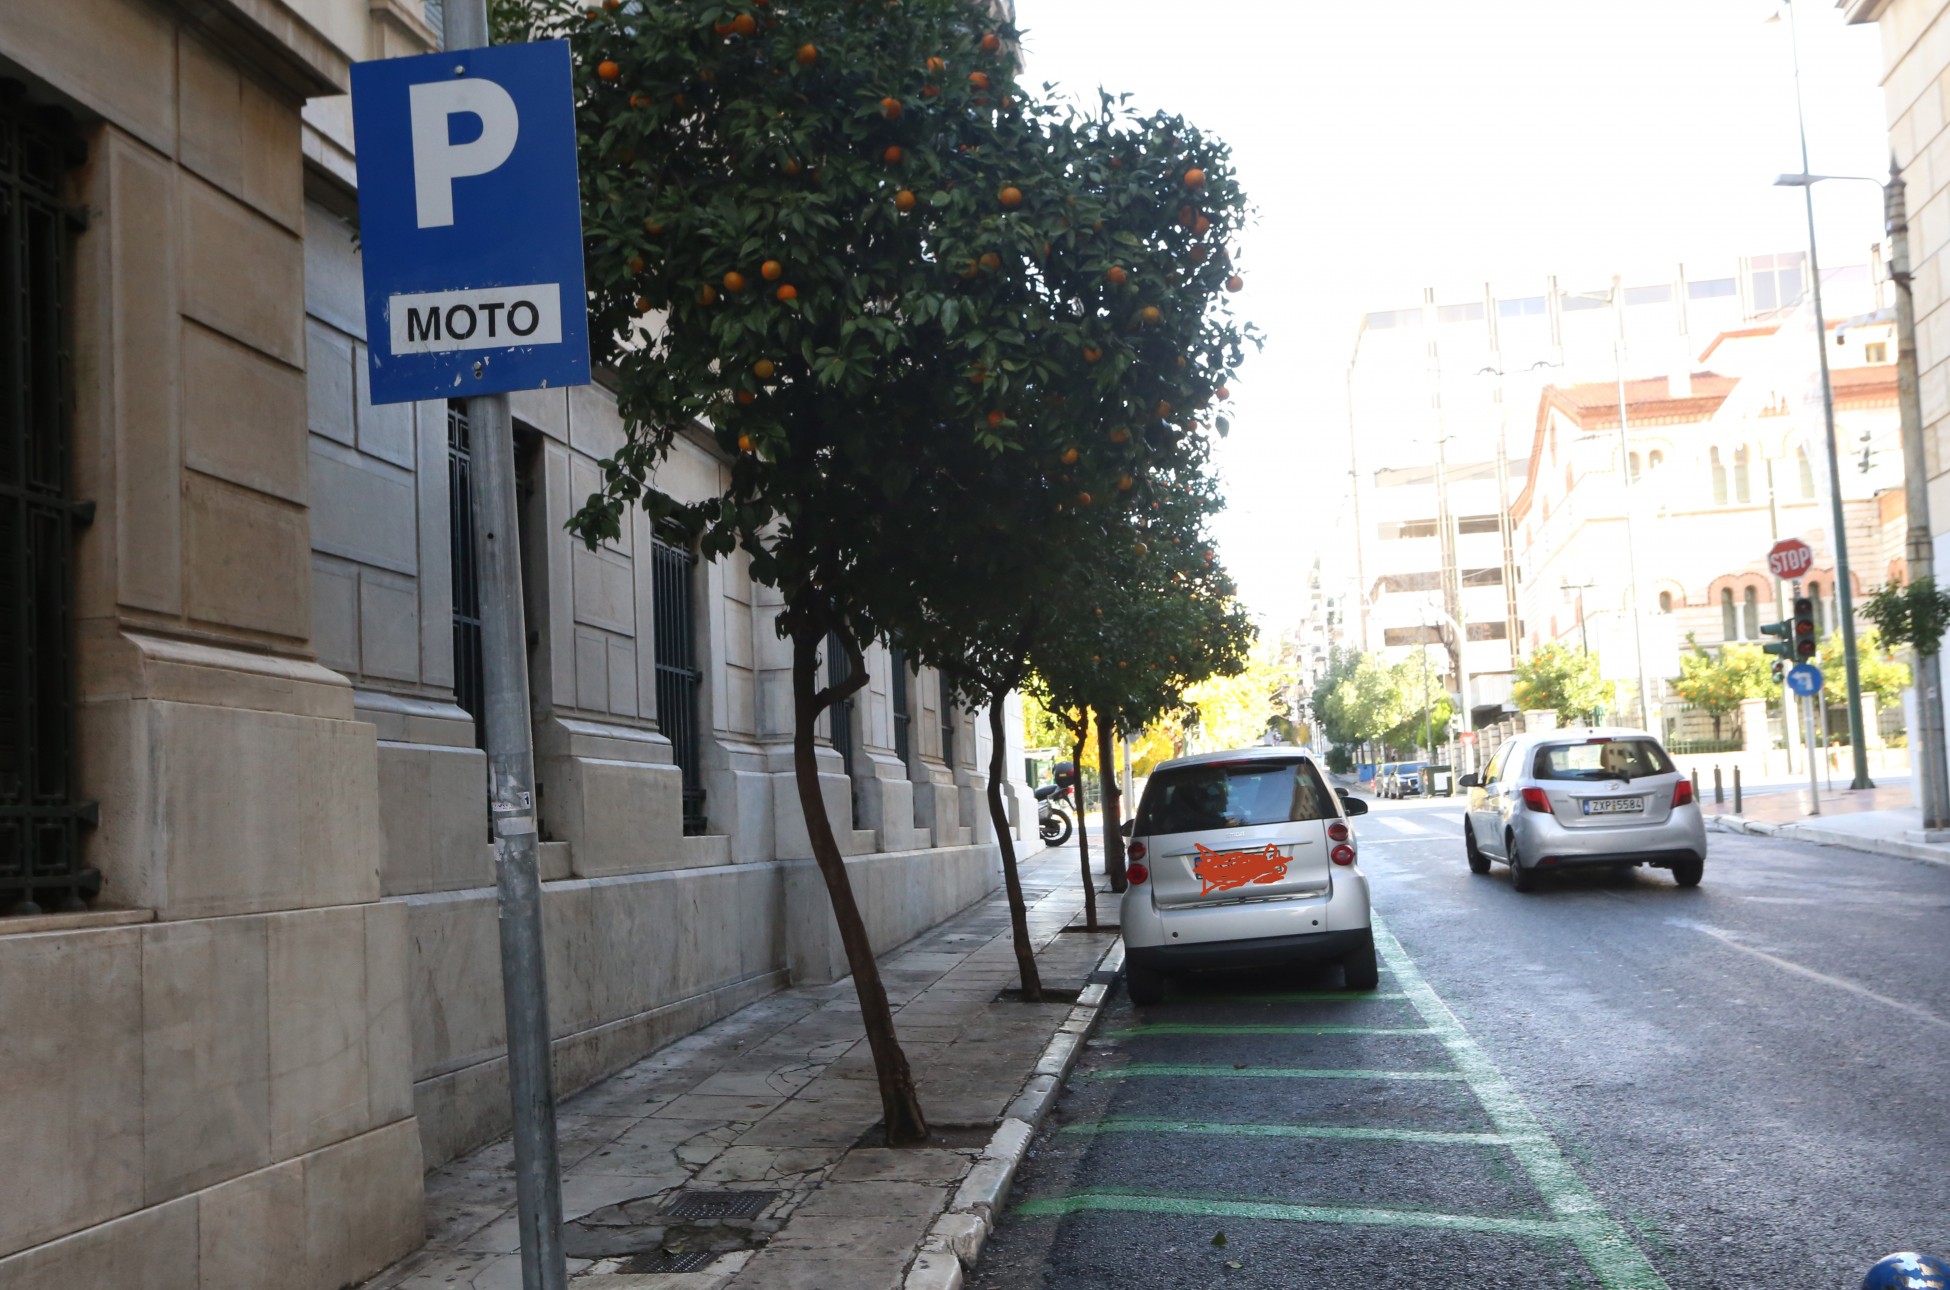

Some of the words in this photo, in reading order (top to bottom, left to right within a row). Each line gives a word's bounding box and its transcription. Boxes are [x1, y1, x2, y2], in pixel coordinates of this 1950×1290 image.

[409, 77, 519, 229] P
[407, 300, 540, 342] MOTO
[1770, 547, 1810, 574] STOP
